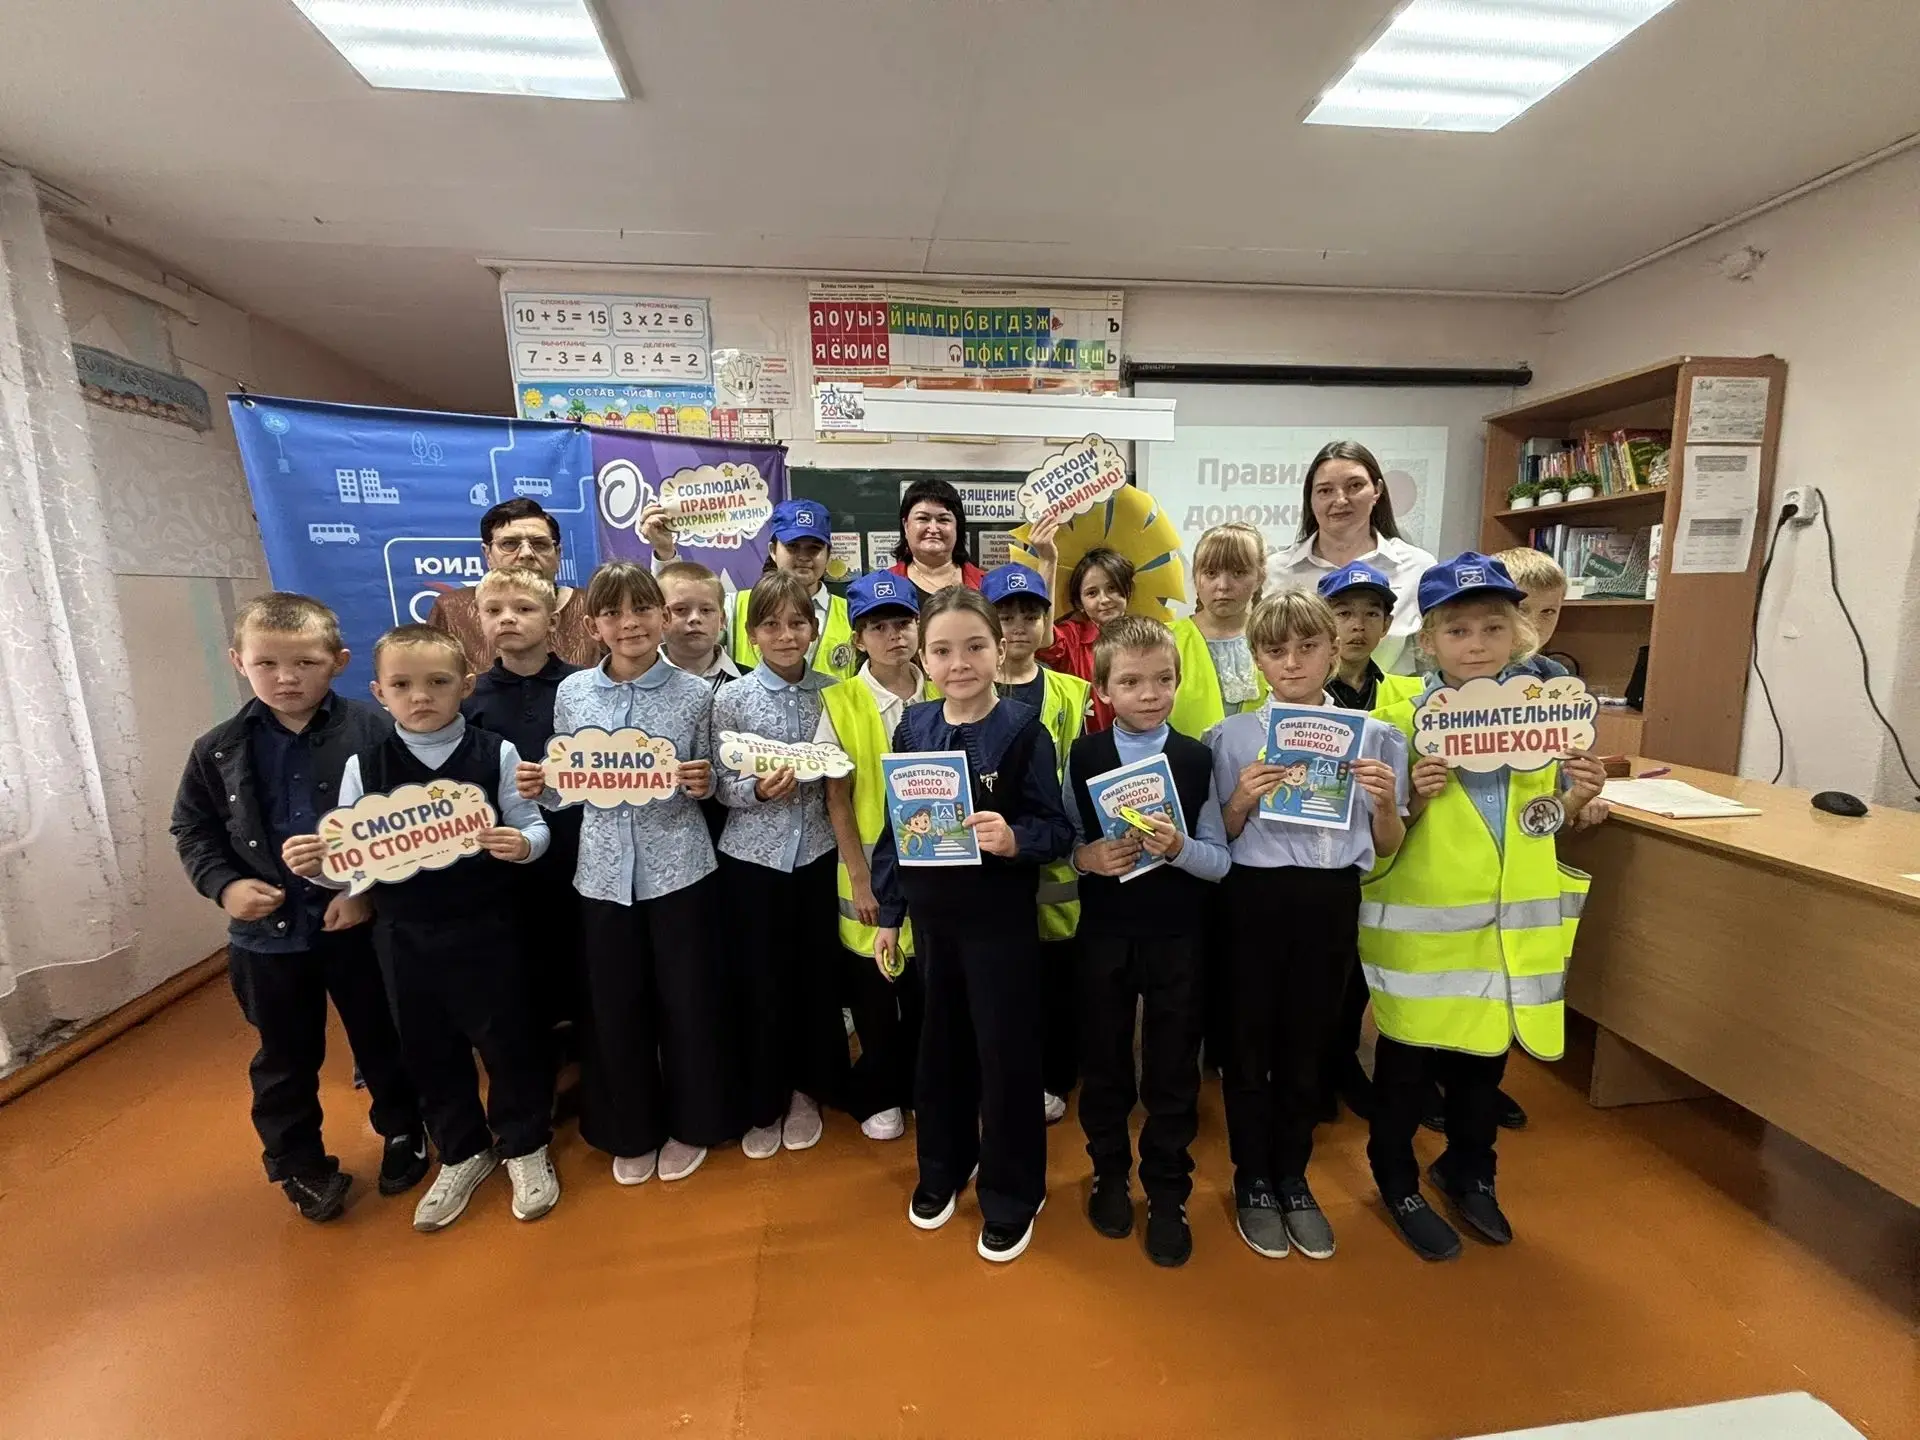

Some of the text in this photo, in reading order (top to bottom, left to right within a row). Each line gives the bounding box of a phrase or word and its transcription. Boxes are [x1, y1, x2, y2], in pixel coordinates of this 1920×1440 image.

[516, 308, 607, 325] 10 + 5 = 15
[623, 312, 632, 326] 3
[653, 313, 664, 326] 2
[668, 316, 678, 324] =
[684, 314, 694, 327] 6
[527, 350, 538, 364] 7
[558, 352, 568, 365] 3
[574, 354, 586, 362] =
[592, 351, 602, 364] 4
[624, 352, 634, 365] 8
[653, 352, 664, 365] 4
[670, 355, 681, 363] =
[687, 353, 698, 367] 2
[568, 388, 615, 398] СОСТАВ
[623, 388, 662, 398] ЧИСЕЛ
[681, 390, 686, 398] 1
[690, 391, 704, 400] до
[820, 394, 836, 404] 20
[1031, 447, 1098, 495] ПЕРЕХОДИ
[1198, 458, 1310, 492] Правил
[678, 476, 750, 498] СОБЛЮДАЙ
[1045, 462, 1100, 504] ДОРОГУ
[960, 488, 1016, 502] ВЯЩЕНИЕ
[680, 494, 746, 514] ПРАВИЛА
[964, 504, 1014, 518] ШЕХОДЫ
[670, 506, 768, 528] СОХРАНЯЙ ЖИЗНЬ!
[414, 556, 484, 577] ЮИД
[1280, 722, 1350, 737] СВИДЕТЕЛЬСТВО
[1294, 730, 1333, 742] ЮНОГО
[1284, 738, 1340, 754] ПЕШЕХОДА
[1444, 727, 1568, 756] ПЕШЕХОД!
[570, 751, 656, 770] Я ЗНАЮ
[558, 771, 672, 790] ПРАВИЛА!
[894, 769, 956, 780] СВИДЕТЕЛЬСТВО
[908, 778, 943, 786] ЮНОГО
[902, 788, 952, 797] ПЕШЕХОДА
[1102, 776, 1160, 802] СВИДЕТЕЛЬСТВО
[1116, 787, 1149, 803] ЮНОГО
[352, 798, 454, 842] СМОТРЮ
[329, 808, 492, 874] ПО СТОРОНАМ!
